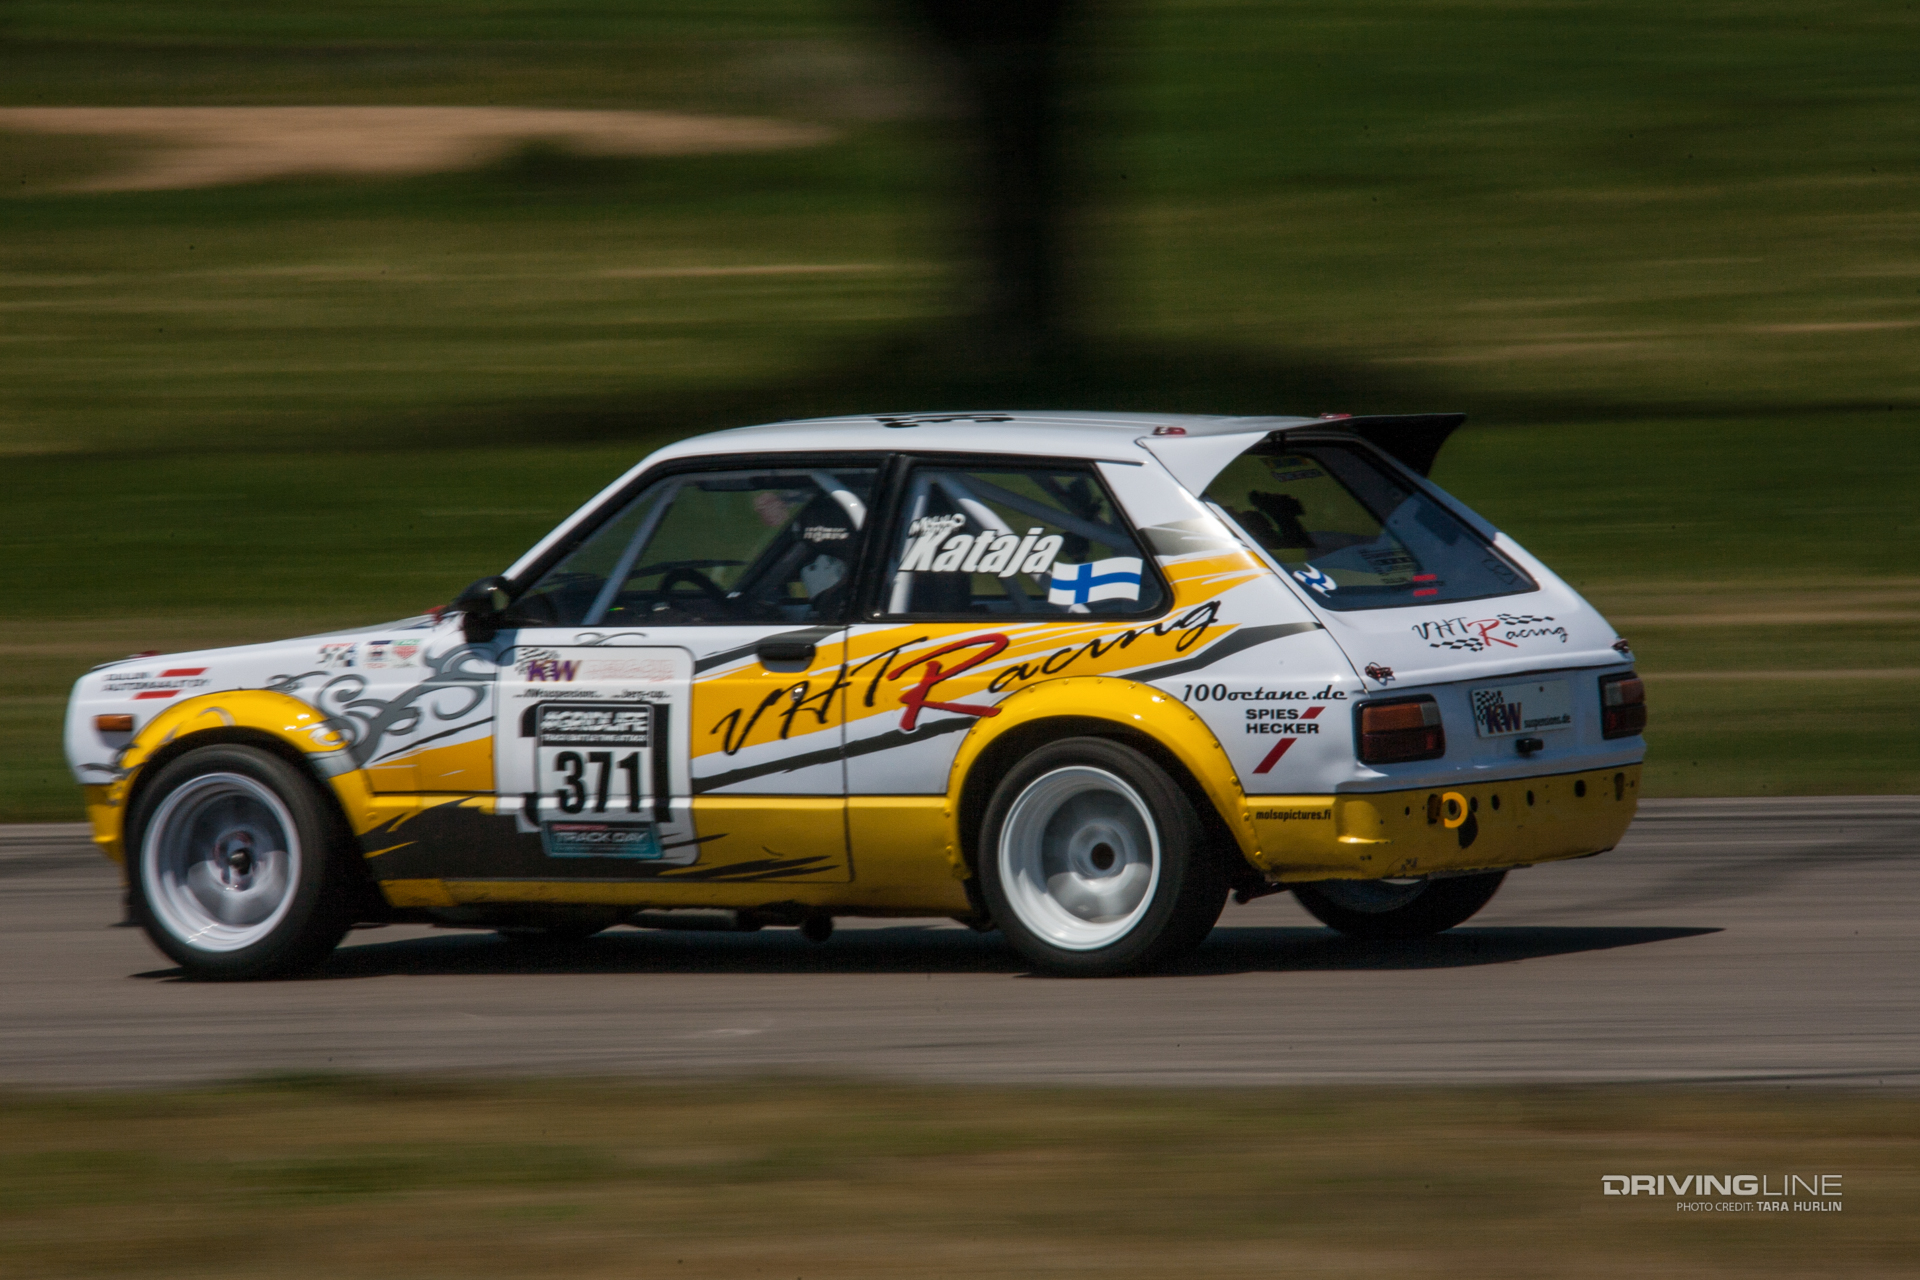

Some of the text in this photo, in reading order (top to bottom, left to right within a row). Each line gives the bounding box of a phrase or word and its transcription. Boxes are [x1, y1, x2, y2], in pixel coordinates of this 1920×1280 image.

[898, 527, 1064, 578] Kataja
[1467, 619, 1568, 648] Racing
[526, 660, 582, 682] KW
[886, 599, 1222, 732] Racing
[1183, 684, 1348, 702] 100octane.de
[1245, 708, 1299, 720] SPIES
[1245, 723, 1319, 734] HECKER
[1486, 702, 1522, 734] KW
[553, 750, 644, 814] 371
